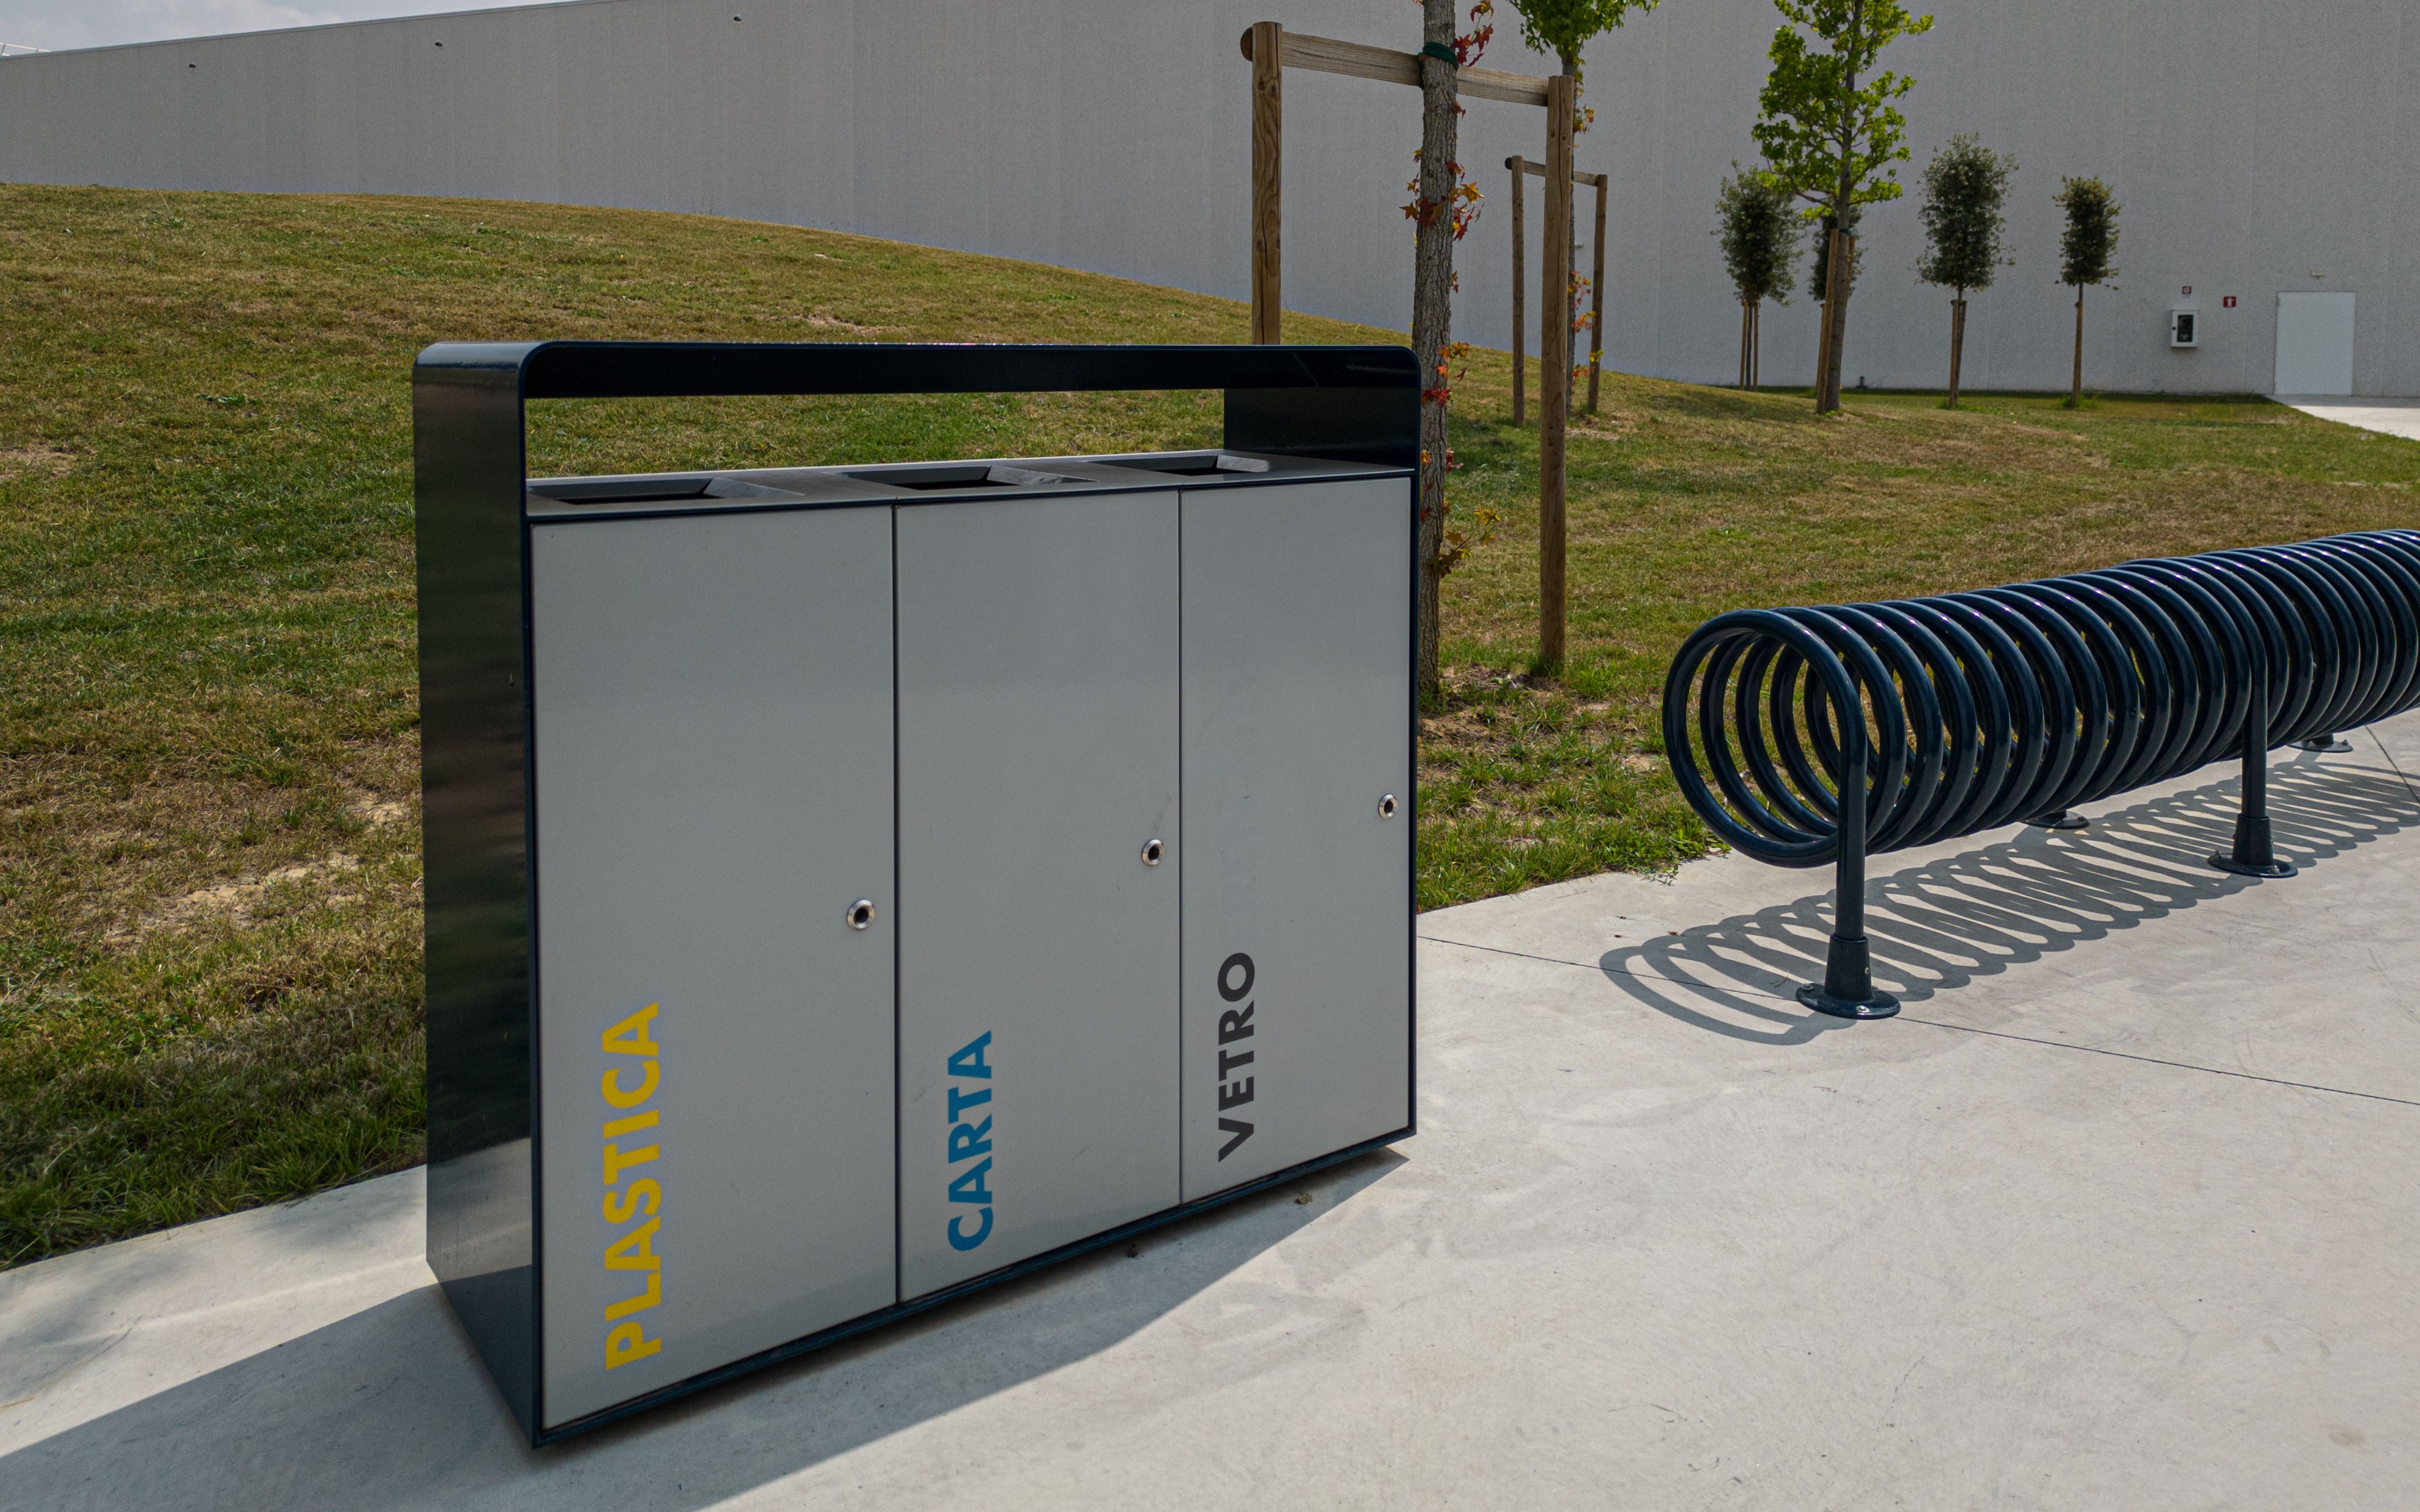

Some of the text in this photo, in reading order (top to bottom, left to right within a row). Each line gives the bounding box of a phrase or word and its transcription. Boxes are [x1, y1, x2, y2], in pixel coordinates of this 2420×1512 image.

[947, 1030, 994, 1251] CARTA
[1217, 952, 1255, 1163] VETRO
[601, 1001, 662, 1370] PLASTICA
